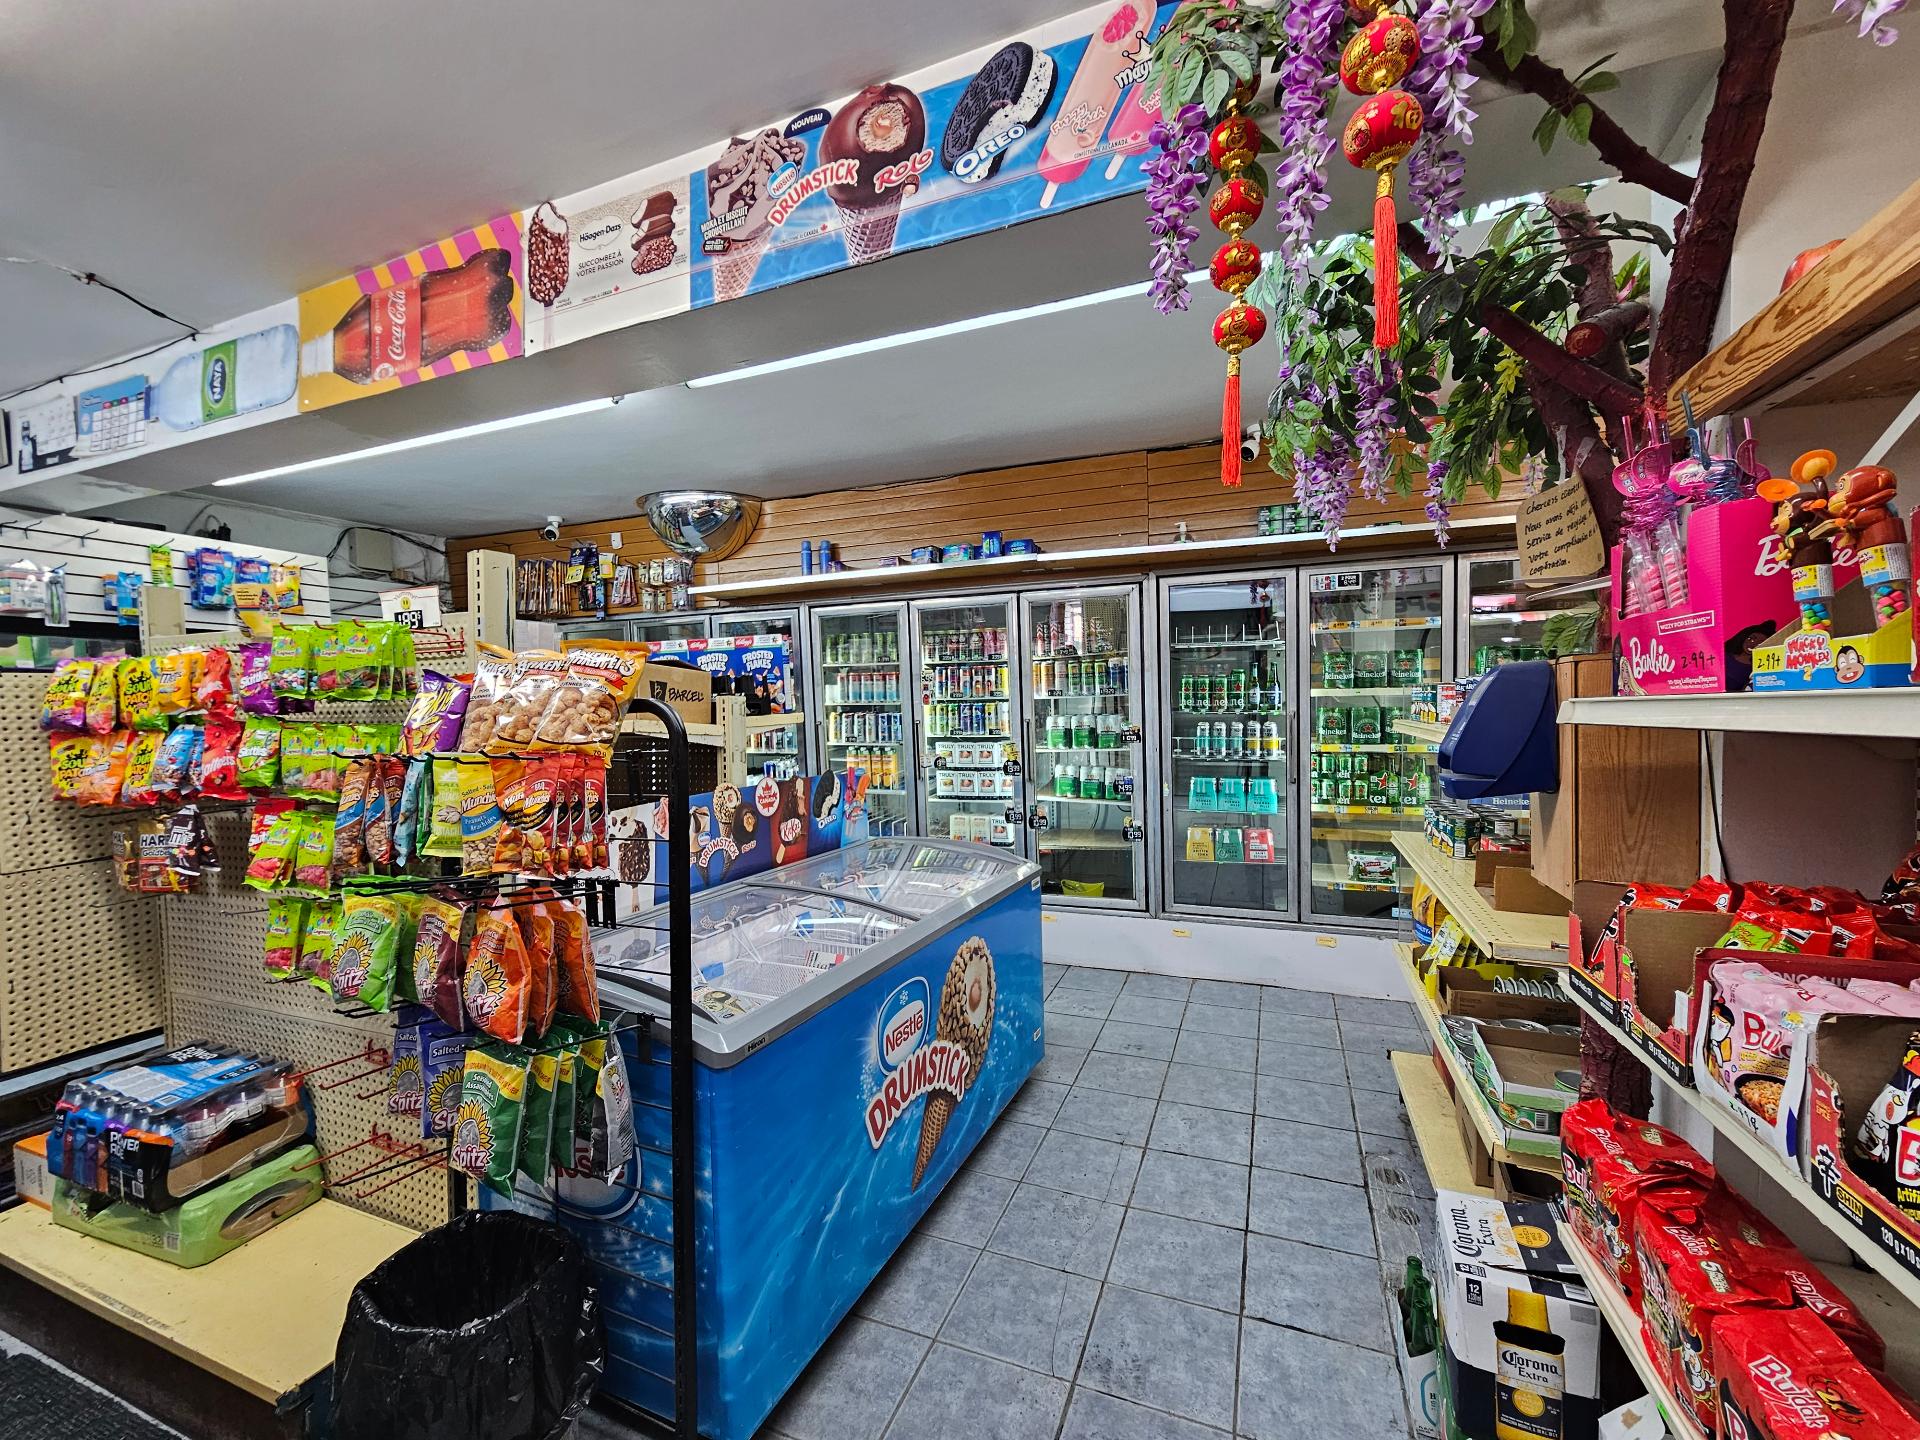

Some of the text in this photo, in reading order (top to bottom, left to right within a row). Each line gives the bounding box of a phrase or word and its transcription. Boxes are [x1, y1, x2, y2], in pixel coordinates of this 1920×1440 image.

[791, 113, 823, 132] NOUVEAU
[953, 124, 1026, 177] OREO
[768, 159, 860, 227] DRUMSTICK
[717, 213, 726, 223] ET
[725, 206, 749, 222] BISCUIT
[576, 257, 624, 278] VOTRE PASSION
[578, 254, 616, 270] SUCCOMBEZ
[388, 288, 406, 361] Coca-Cola
[212, 360, 224, 399] NAYA
[1785, 634, 1826, 654] WACKY
[697, 653, 729, 666] FROSTED
[701, 662, 727, 672] FLAKES
[742, 650, 774, 664] FROSTED
[746, 659, 772, 672] FLAKES
[1630, 637, 1676, 680] Barbie
[1785, 650, 1831, 670] MONKEY
[668, 688, 704, 703] BARCEL
[461, 785, 480, 798] Salted
[465, 814, 488, 826] Peanuts
[818, 814, 837, 829] OREO
[699, 836, 740, 868] DRUMSTICK
[885, 1008, 924, 1056] Nestlé
[432, 1045, 461, 1058] Salted
[748, 1036, 766, 1052] Hiron
[867, 1042, 969, 1146] DRUMSTICK
[110, 1131, 140, 1153] POWER
[110, 1143, 125, 1161] ADE
[452, 1144, 488, 1171] Spitz
[1837, 1188, 1864, 1218] SHIN
[1450, 1207, 1483, 1258] Corona
[1477, 1219, 1496, 1249] Extra
[1881, 1226, 1894, 1243] 120
[1894, 1240, 1901, 1255] g
[1905, 1246, 1916, 1263] 10
[1468, 1283, 1480, 1295] 12
[1501, 1349, 1560, 1378] Corona
[1518, 1366, 1549, 1384] Extra
